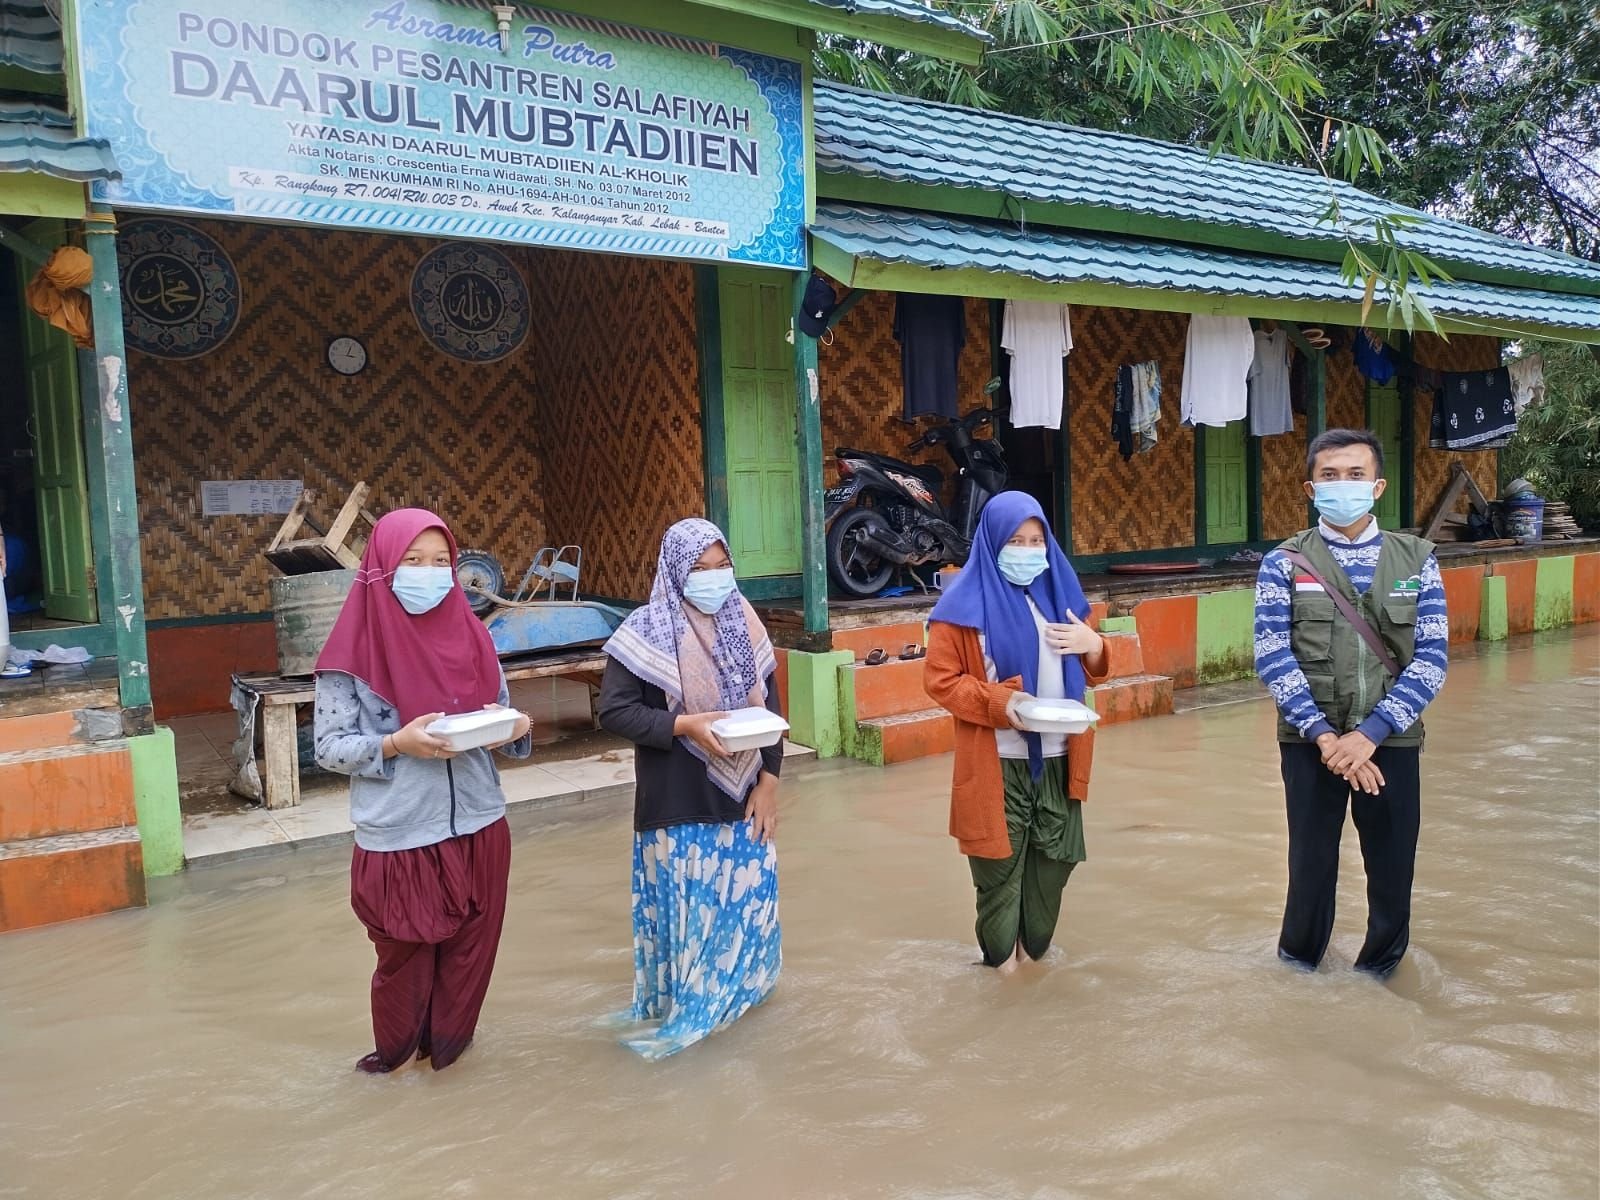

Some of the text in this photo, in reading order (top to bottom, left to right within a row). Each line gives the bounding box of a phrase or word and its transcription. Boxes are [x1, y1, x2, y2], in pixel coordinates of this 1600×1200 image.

[365, 2, 616, 69] Asrama Putra
[179, 13, 750, 131] PONDOK PESANTREN SALAFIYAH
[171, 51, 759, 176] DAARUL MUBTADIIEN
[287, 121, 688, 187] YAYASAN DAARUL MUBTADIIEN AL-KHOLIK
[287, 143, 320, 157] Akta
[324, 147, 375, 164] Notaris
[386, 155, 458, 174] Crescentia
[461, 164, 490, 178] Erna
[493, 168, 551, 186] Widawati,
[554, 176, 575, 188] SH.
[578, 179, 596, 191] No.
[599, 182, 629, 194] 03.07
[632, 187, 663, 199] Maret
[665, 190, 691, 202] 2012
[239, 170, 265, 187] Kp.
[274, 175, 338, 197] Rangkong
[460, 195, 481, 208] Ds.
[486, 200, 518, 213] Aweh
[522, 203, 544, 216] Kec.
[551, 206, 618, 226] Kalanganyar
[621, 213, 645, 227] Kab.
[650, 217, 680, 231] Lebak
[694, 221, 726, 235] Banten
[319, 163, 669, 214] SK. MENKUMHAM RI No. AHU-1694-AH-01.04 Tahun 2012
